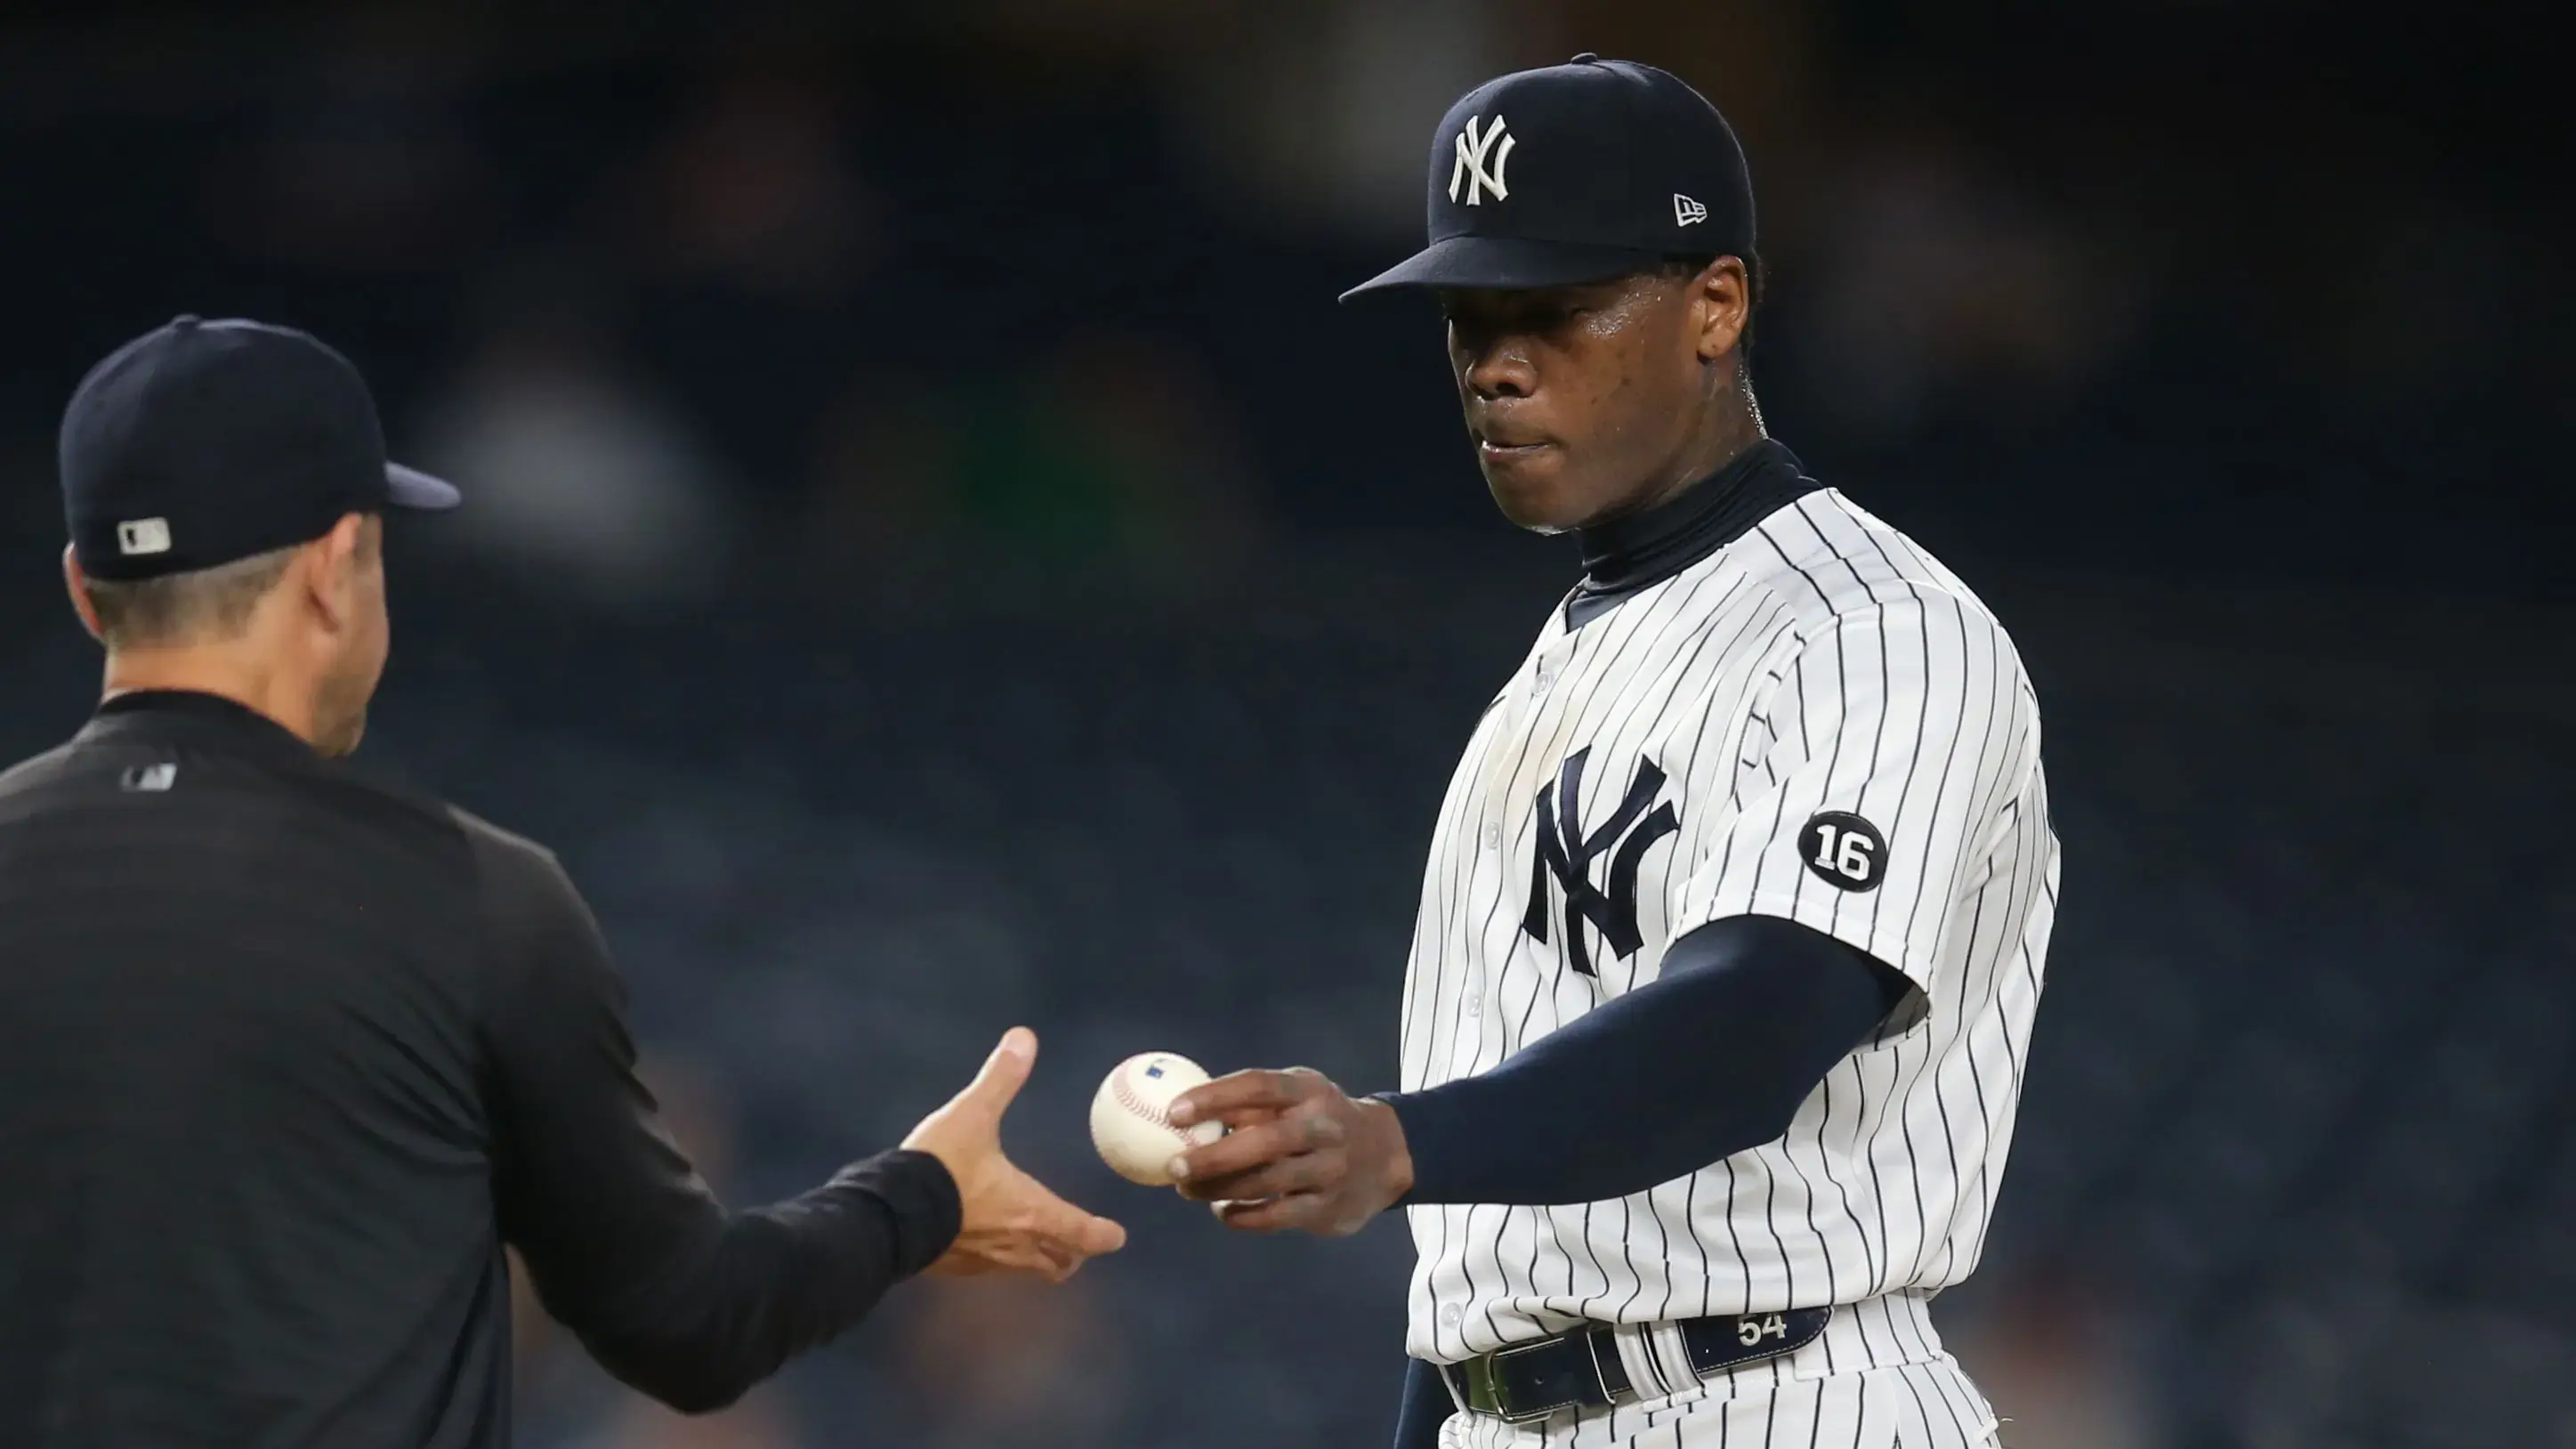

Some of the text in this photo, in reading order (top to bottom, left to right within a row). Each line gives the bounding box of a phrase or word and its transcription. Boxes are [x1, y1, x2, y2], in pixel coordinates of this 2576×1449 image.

[1449, 114, 1516, 206] NY
[1522, 744, 1681, 978] NY
[1814, 824, 1875, 881] 16
[1738, 1314, 1787, 1347] 54
